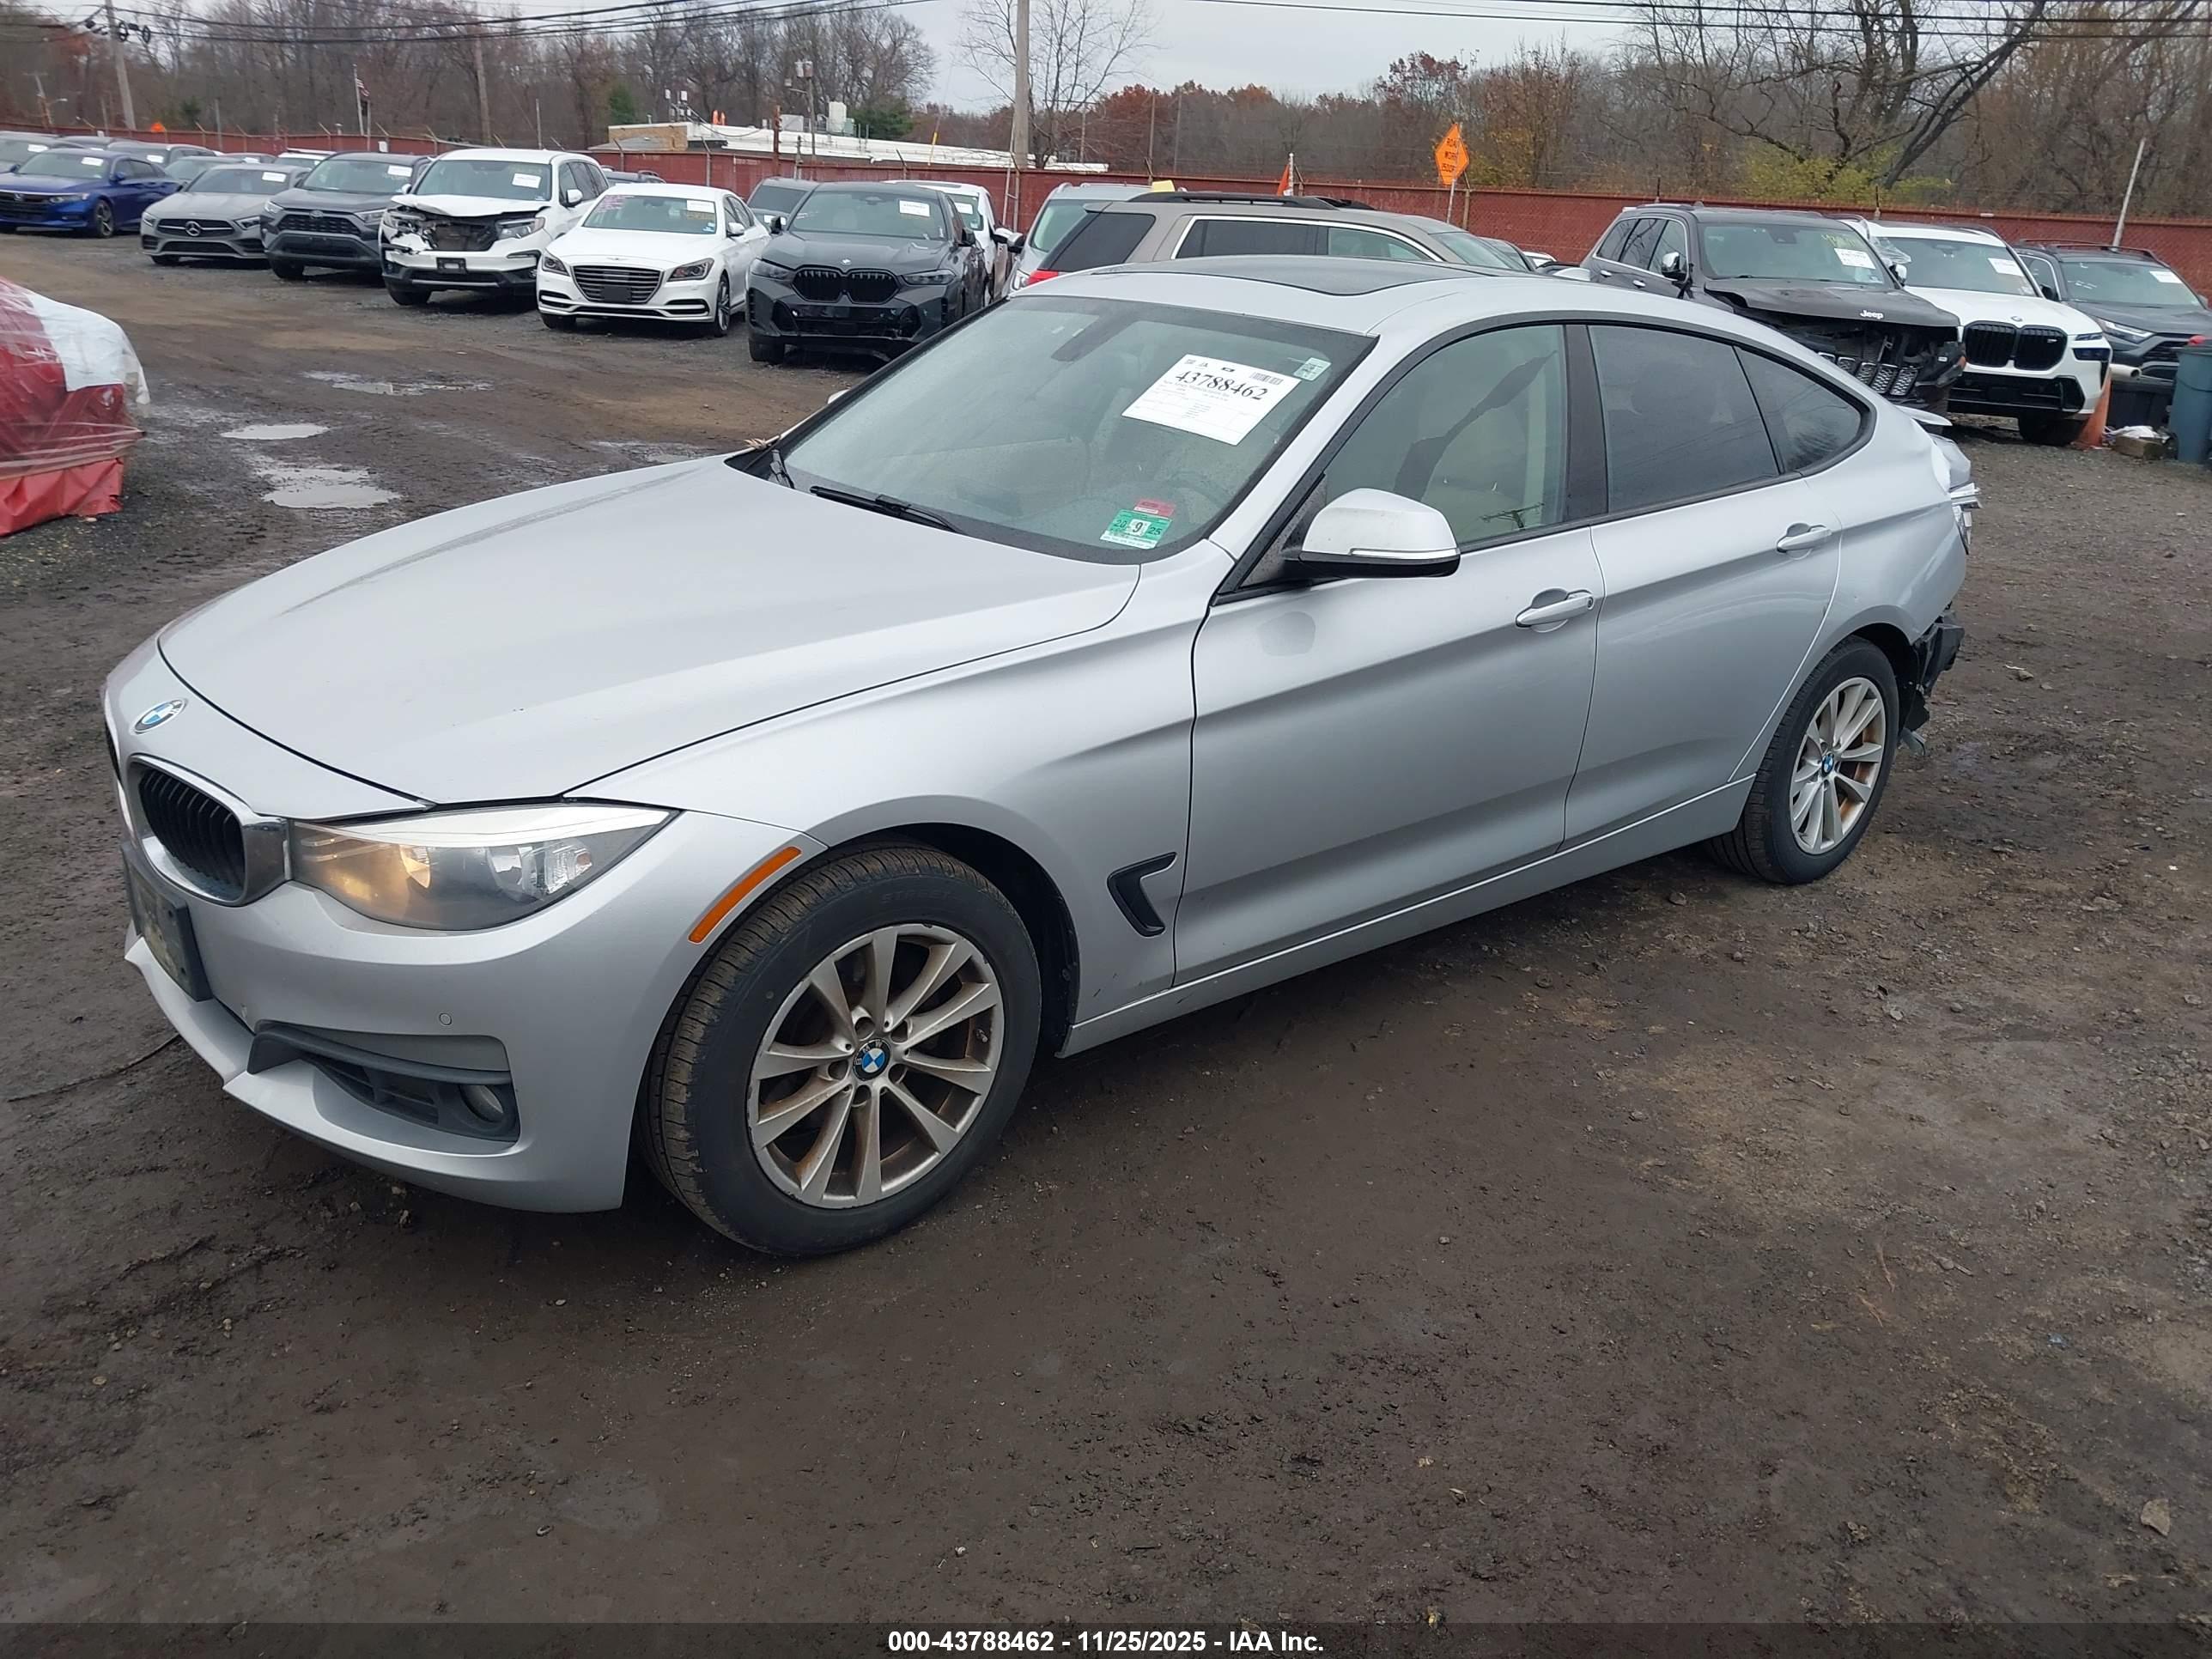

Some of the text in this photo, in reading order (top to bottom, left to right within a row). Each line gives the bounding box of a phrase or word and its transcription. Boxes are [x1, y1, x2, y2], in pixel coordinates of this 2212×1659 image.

[1860, 309, 1884, 319] Jeep
[1176, 370, 1267, 400] 43788462
[1114, 520, 1163, 536] 20 9 25
